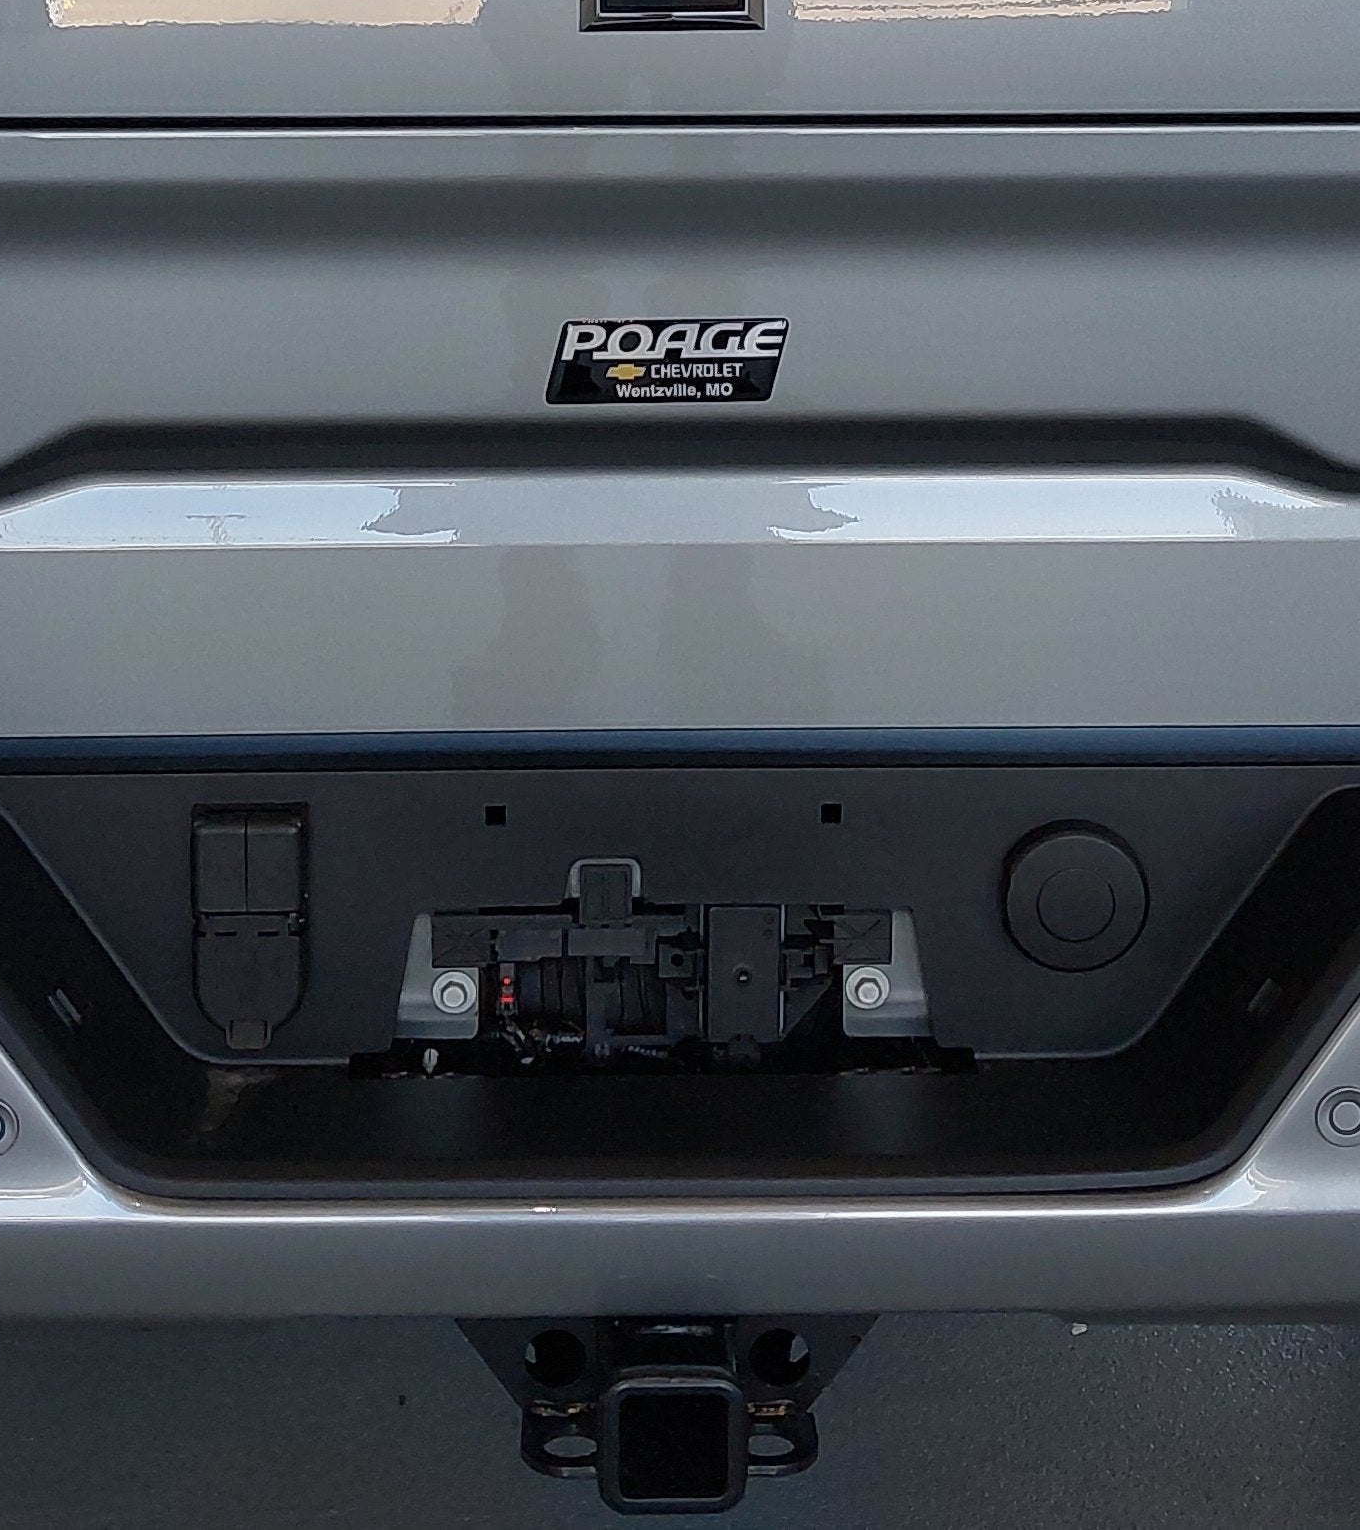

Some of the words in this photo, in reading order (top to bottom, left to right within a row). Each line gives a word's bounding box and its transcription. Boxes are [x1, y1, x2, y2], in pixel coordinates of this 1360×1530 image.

[561, 321, 787, 360] POAGE
[650, 363, 744, 379] CHEVROLET
[616, 383, 702, 399] Wentzville,
[706, 382, 734, 397] MO
